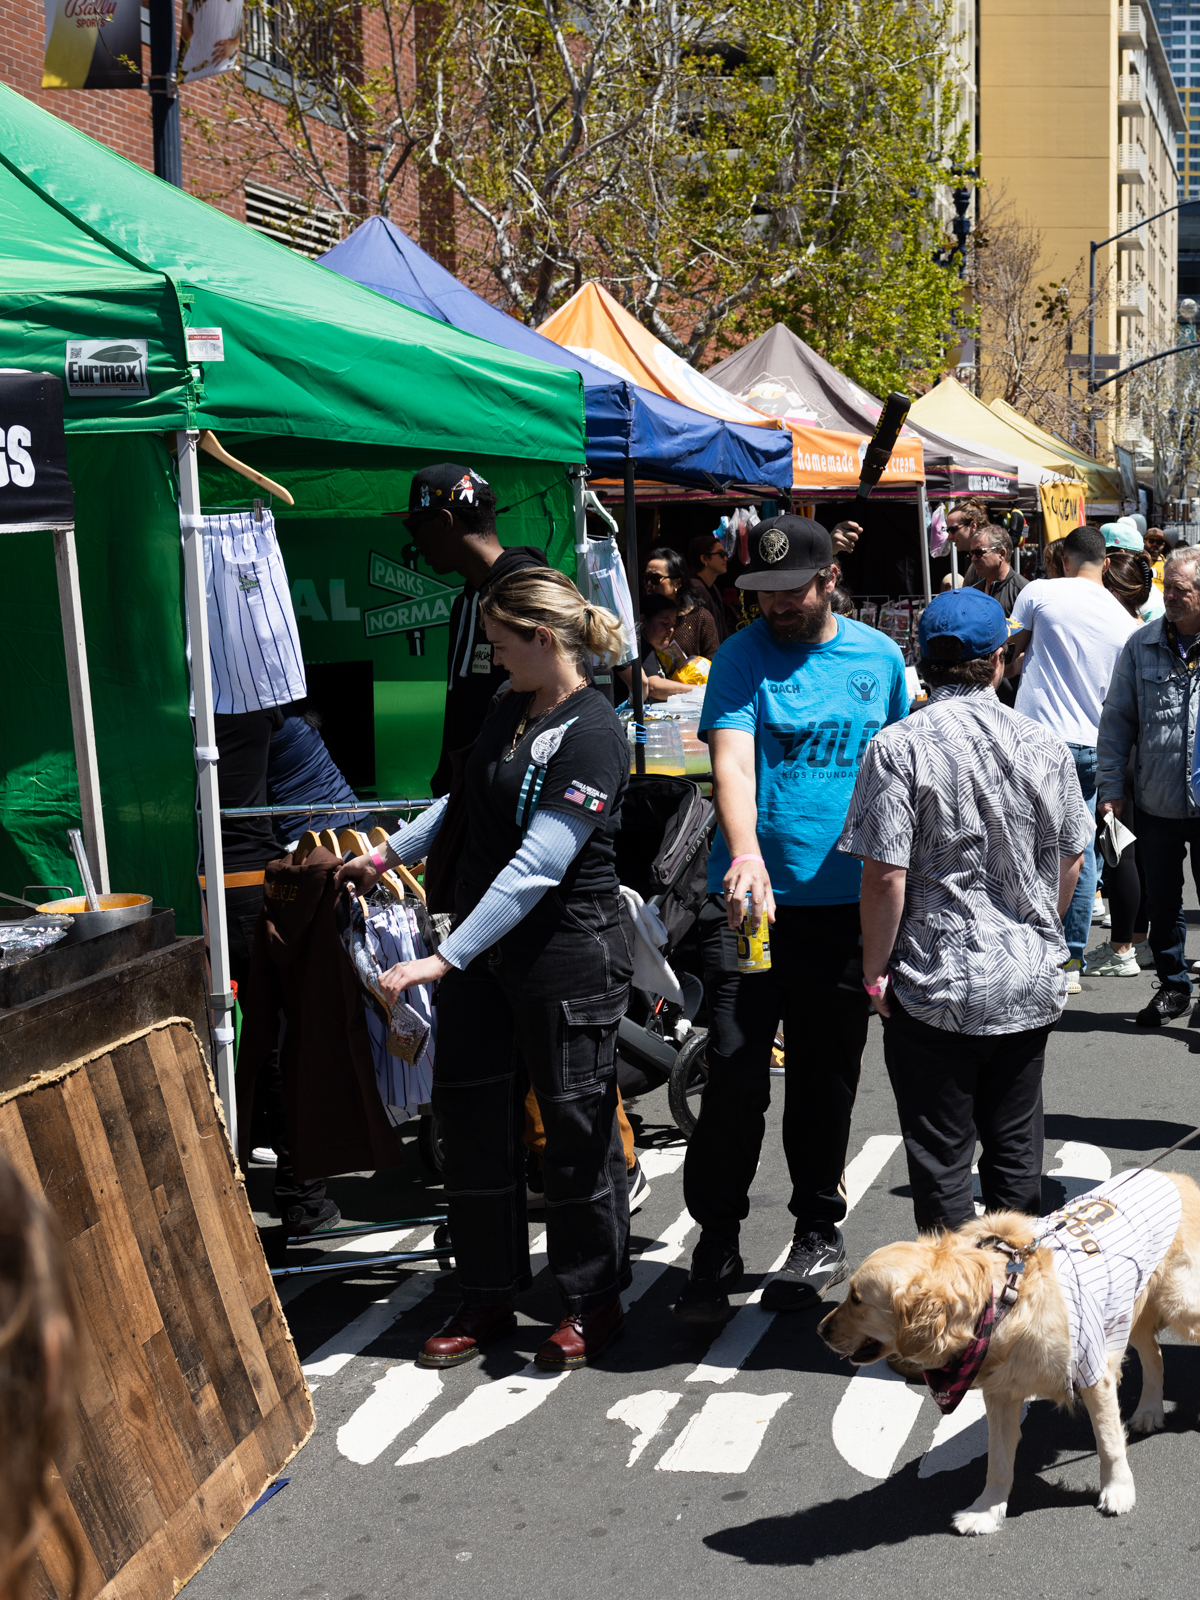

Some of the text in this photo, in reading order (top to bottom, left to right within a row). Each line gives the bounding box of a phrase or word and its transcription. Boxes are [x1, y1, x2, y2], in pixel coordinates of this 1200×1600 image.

[64, 0, 117, 19] Bally
[76, 17, 106, 28] SPORTS
[68, 361, 139, 384] Eurmax
[797, 446, 854, 473] homemade
[891, 456, 916, 473] cream
[374, 559, 424, 596] PARKS
[685, 826, 711, 862] GUAVA
